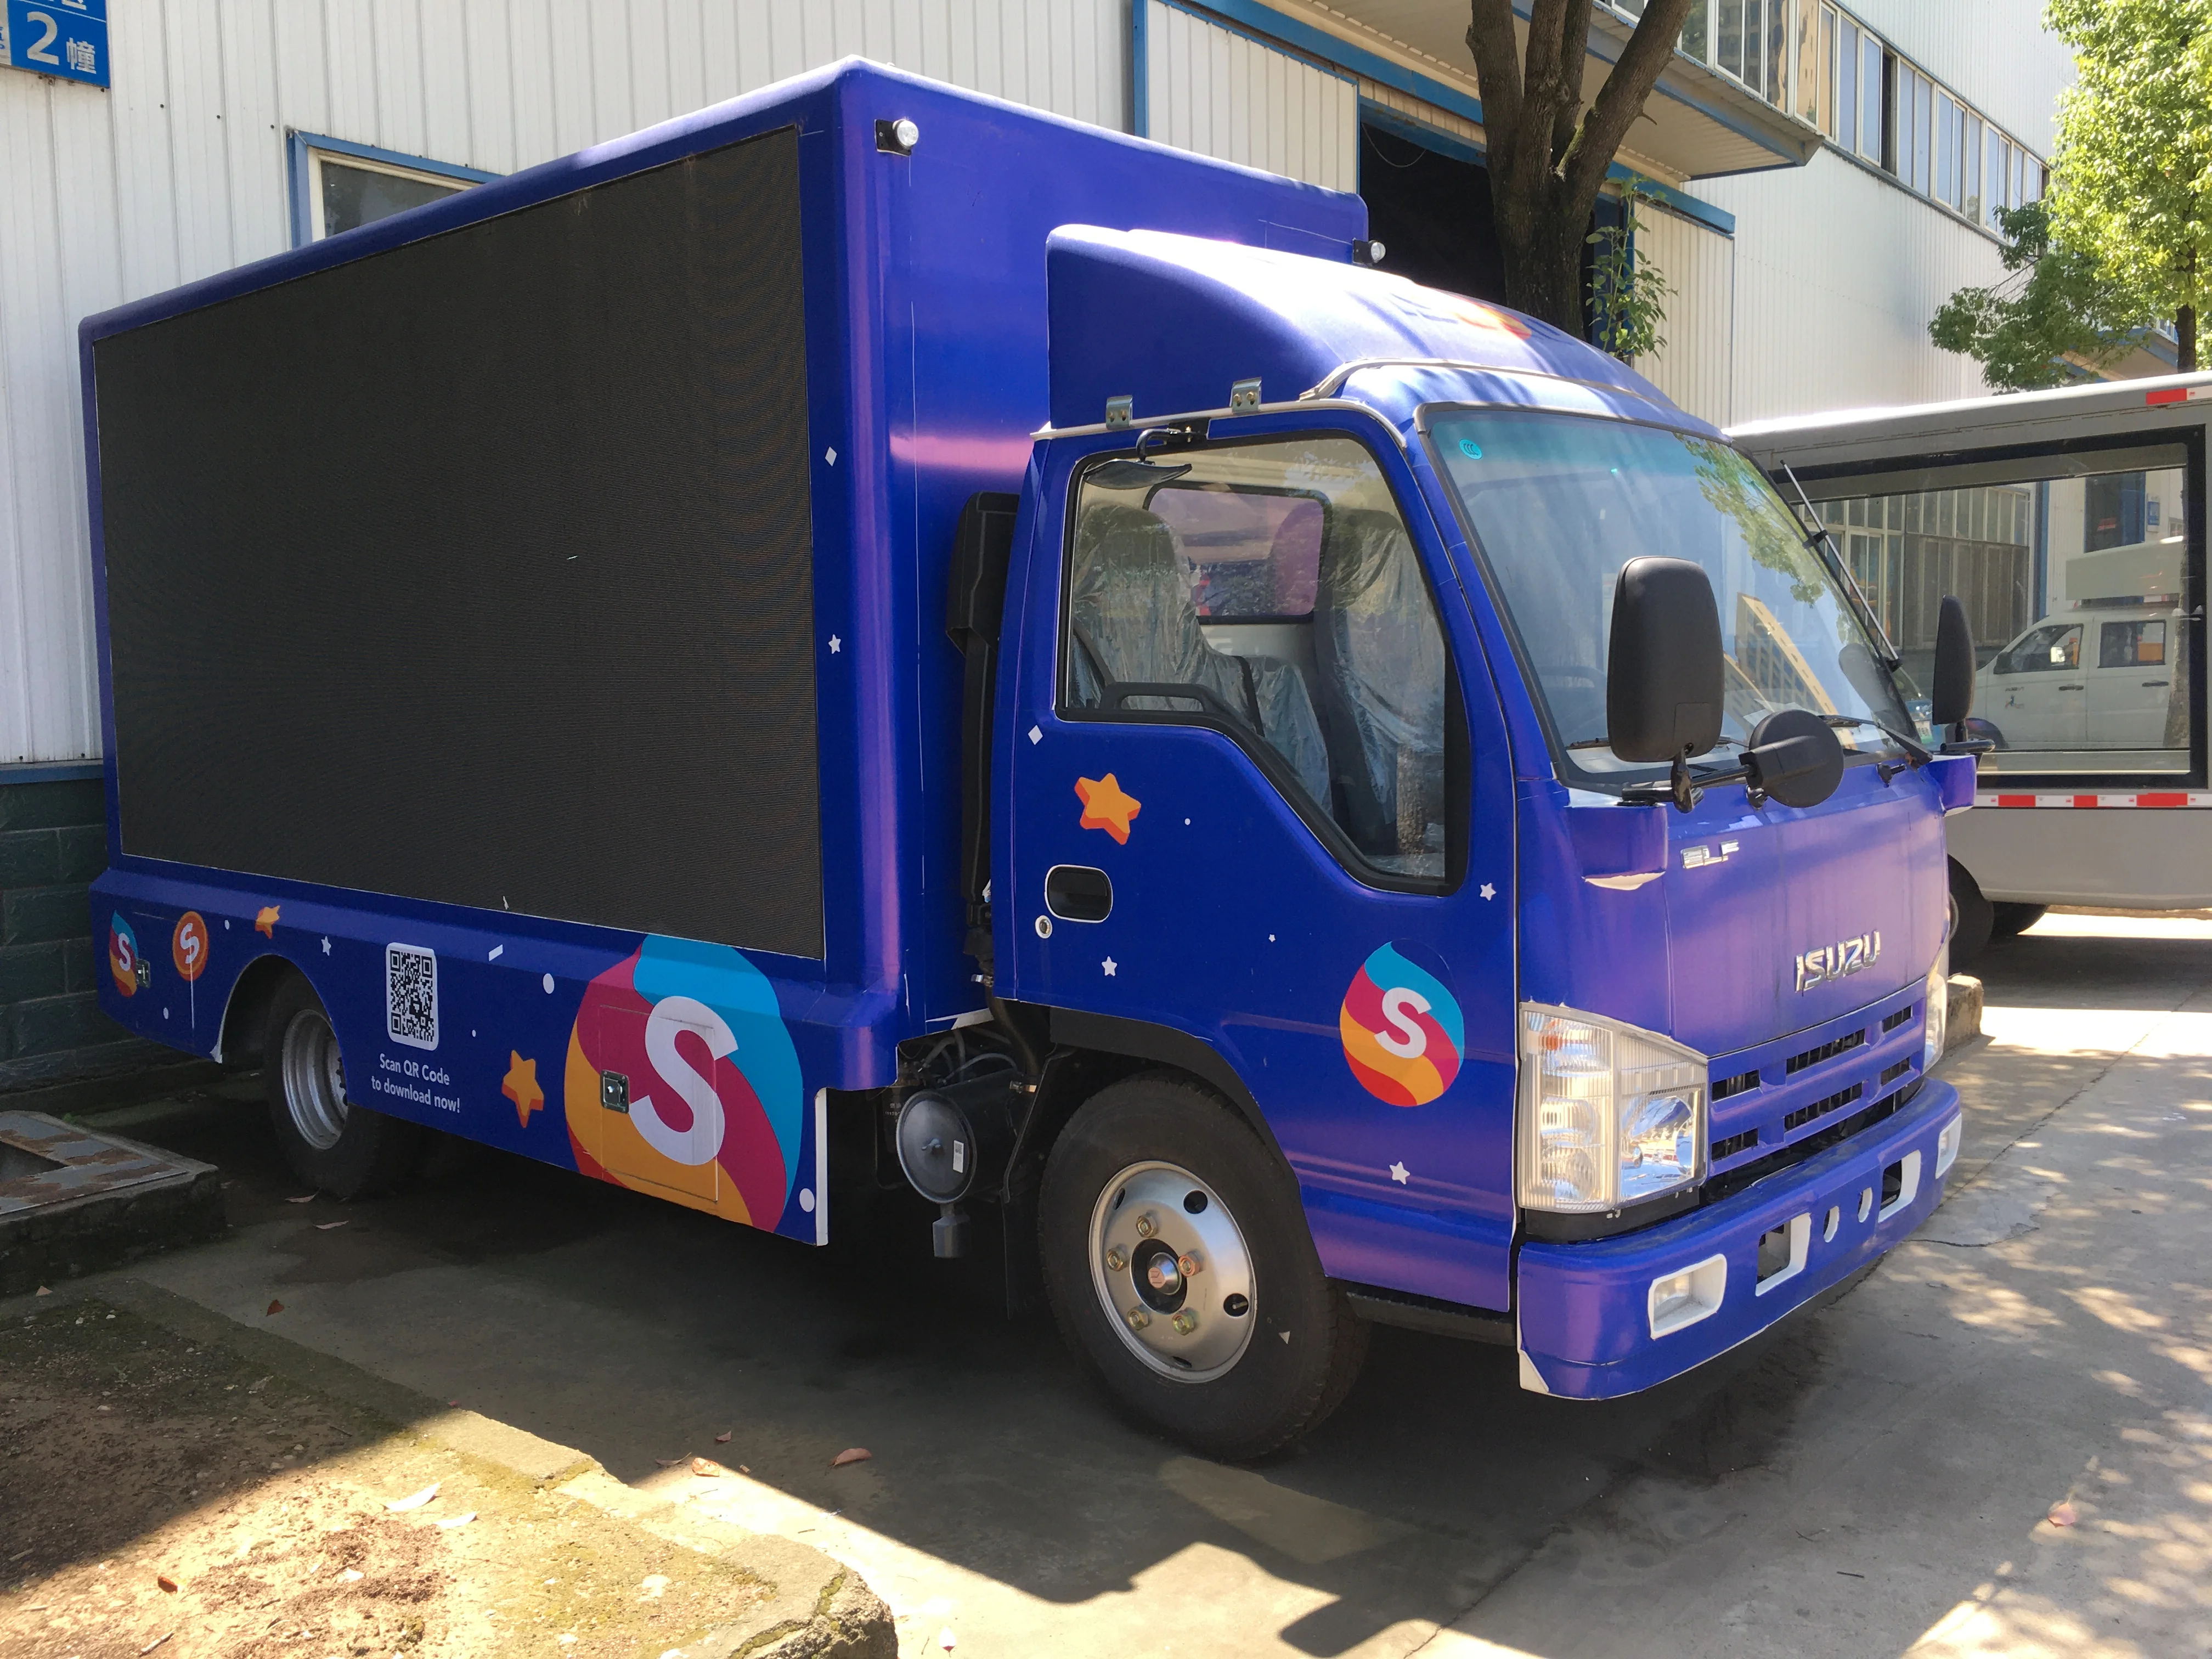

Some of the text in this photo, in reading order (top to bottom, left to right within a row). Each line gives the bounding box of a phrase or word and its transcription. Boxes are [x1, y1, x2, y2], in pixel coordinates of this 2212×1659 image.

[119, 933, 131, 972] S
[180, 923, 200, 964] S
[1795, 929, 1881, 993] ISUZU
[1374, 987, 1431, 1059] S
[380, 1053, 450, 1085] Scan QR Code
[629, 995, 738, 1166] S
[371, 1075, 460, 1114] to download now!
